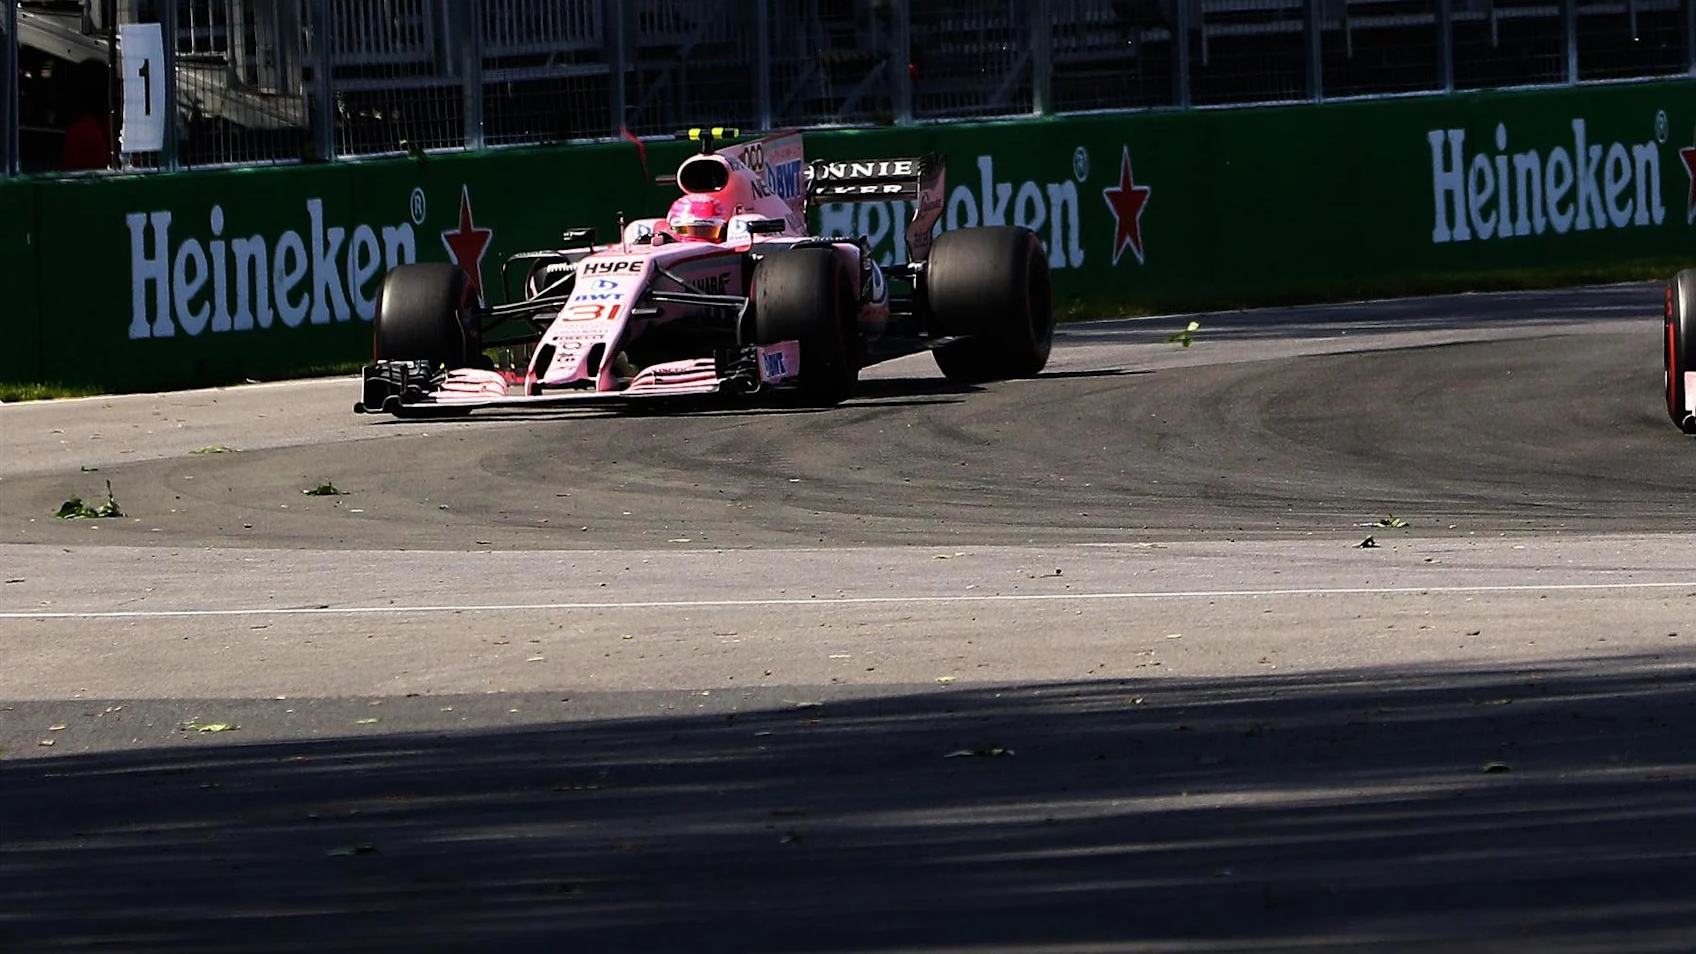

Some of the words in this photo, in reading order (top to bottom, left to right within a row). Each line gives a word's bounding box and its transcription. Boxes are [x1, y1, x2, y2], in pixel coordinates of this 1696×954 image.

[138, 58, 151, 116] 1
[1428, 118, 1666, 243] Heineken
[582, 260, 644, 275] HYPE
[561, 303, 622, 323] 31
